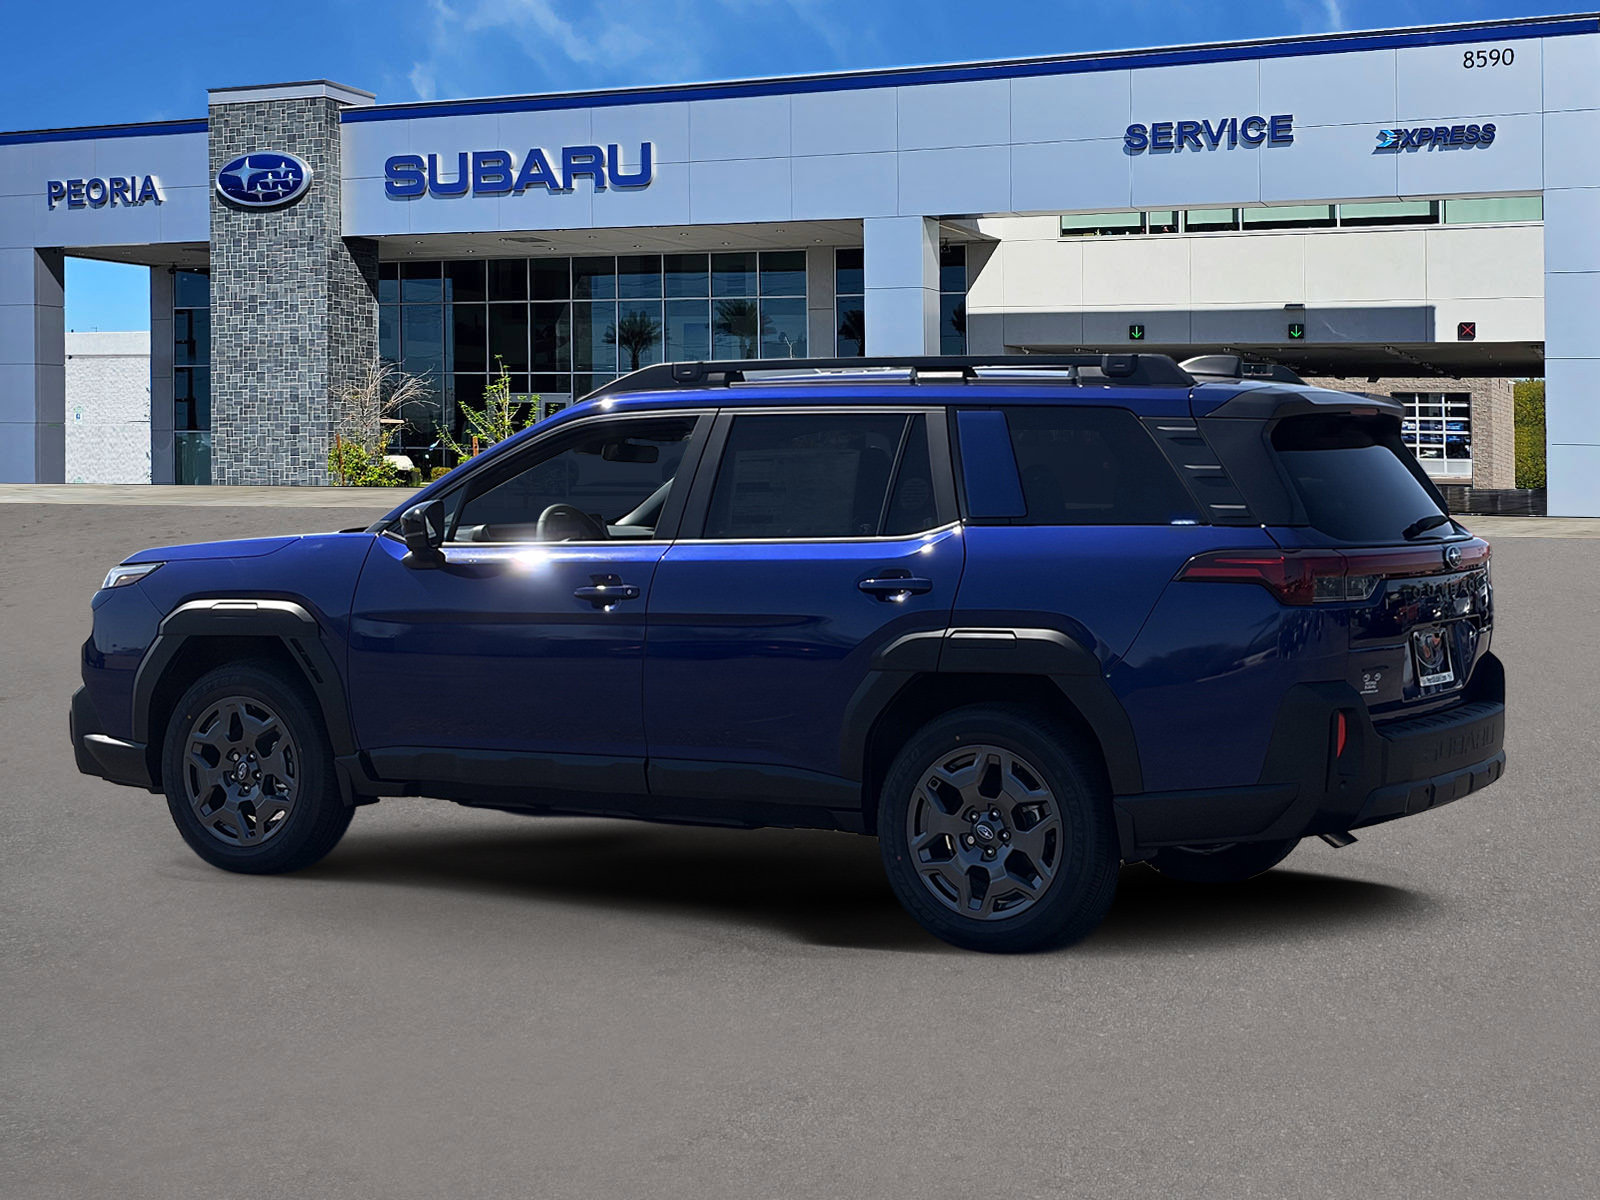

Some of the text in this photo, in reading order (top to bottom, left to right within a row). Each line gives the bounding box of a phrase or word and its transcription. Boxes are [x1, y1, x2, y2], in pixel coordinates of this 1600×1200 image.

[1463, 48, 1515, 69] 8590
[1125, 114, 1294, 153] SERVICE
[1376, 123, 1497, 149] EXPRESS
[47, 142, 653, 209] PEORIA SUBARU
